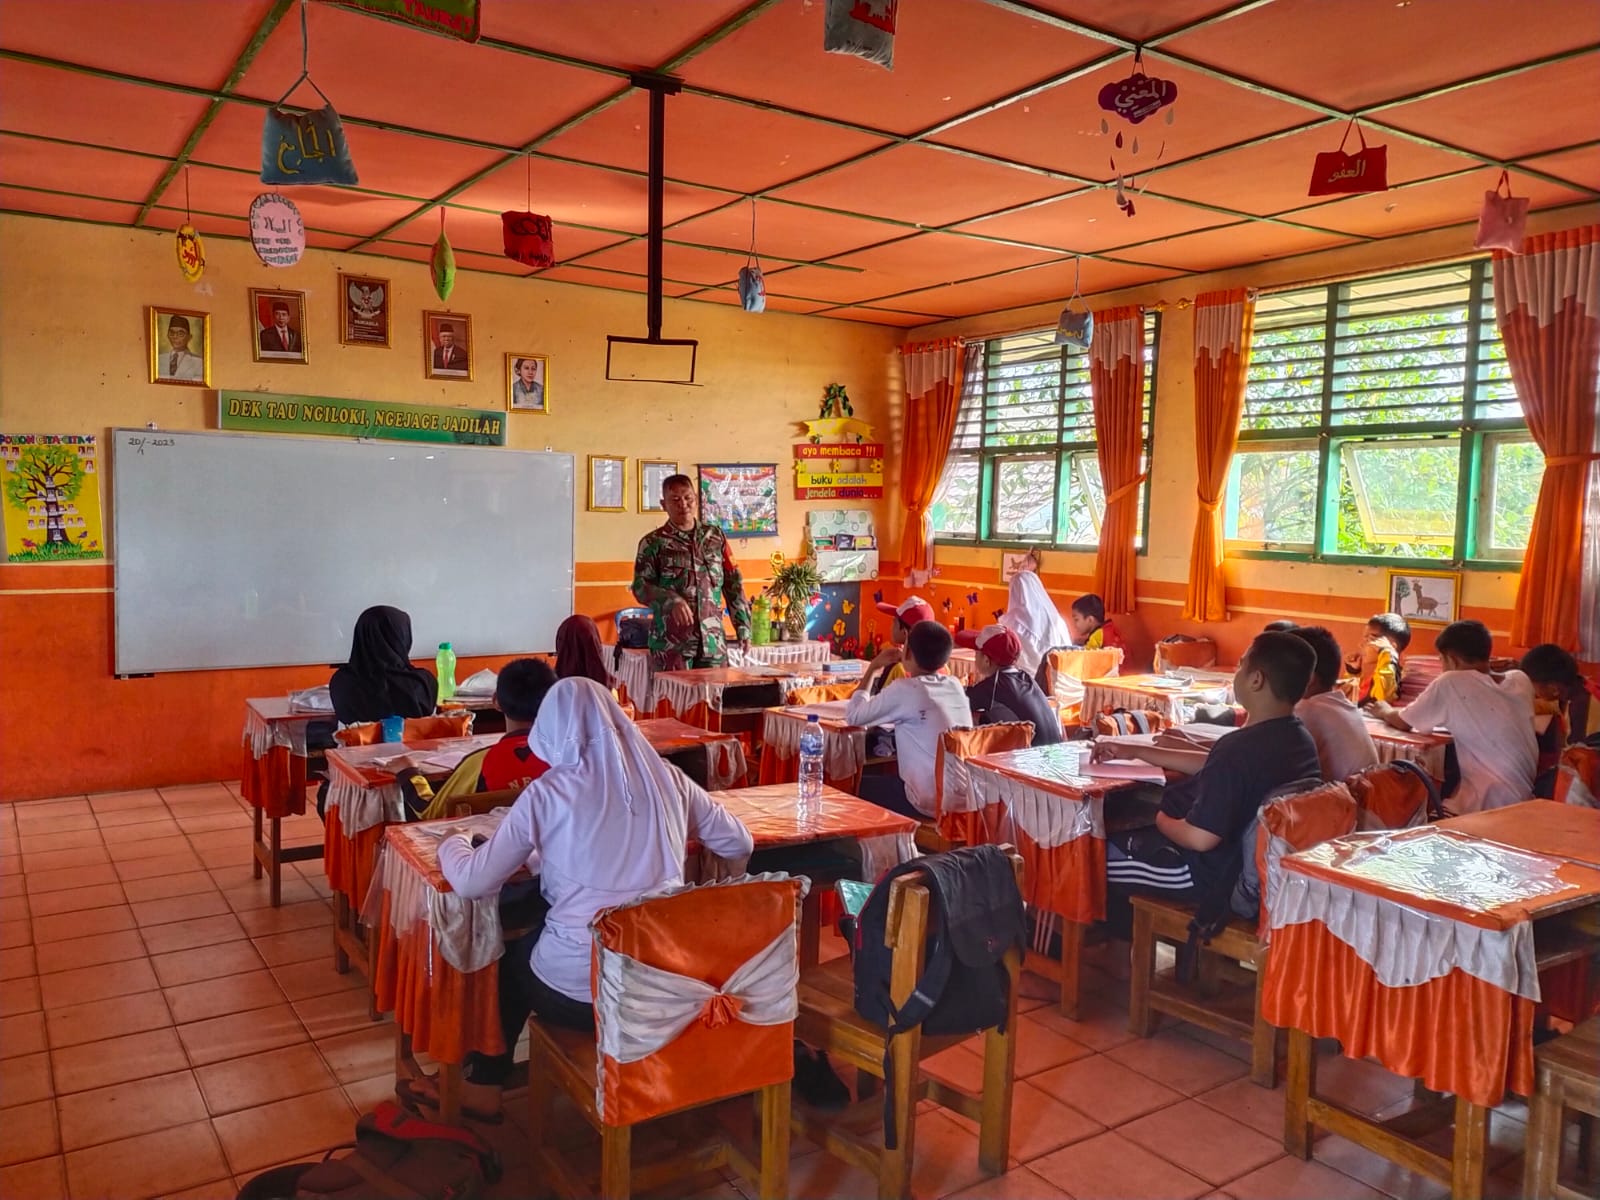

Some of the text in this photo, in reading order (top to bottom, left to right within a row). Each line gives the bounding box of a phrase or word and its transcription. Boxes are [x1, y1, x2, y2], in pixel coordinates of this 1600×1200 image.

[229, 399, 501, 436] DEK TAU NGILOKI, NGEJAGE JADILAH
[802, 447, 818, 457] ayo
[820, 446, 861, 456] membaca
